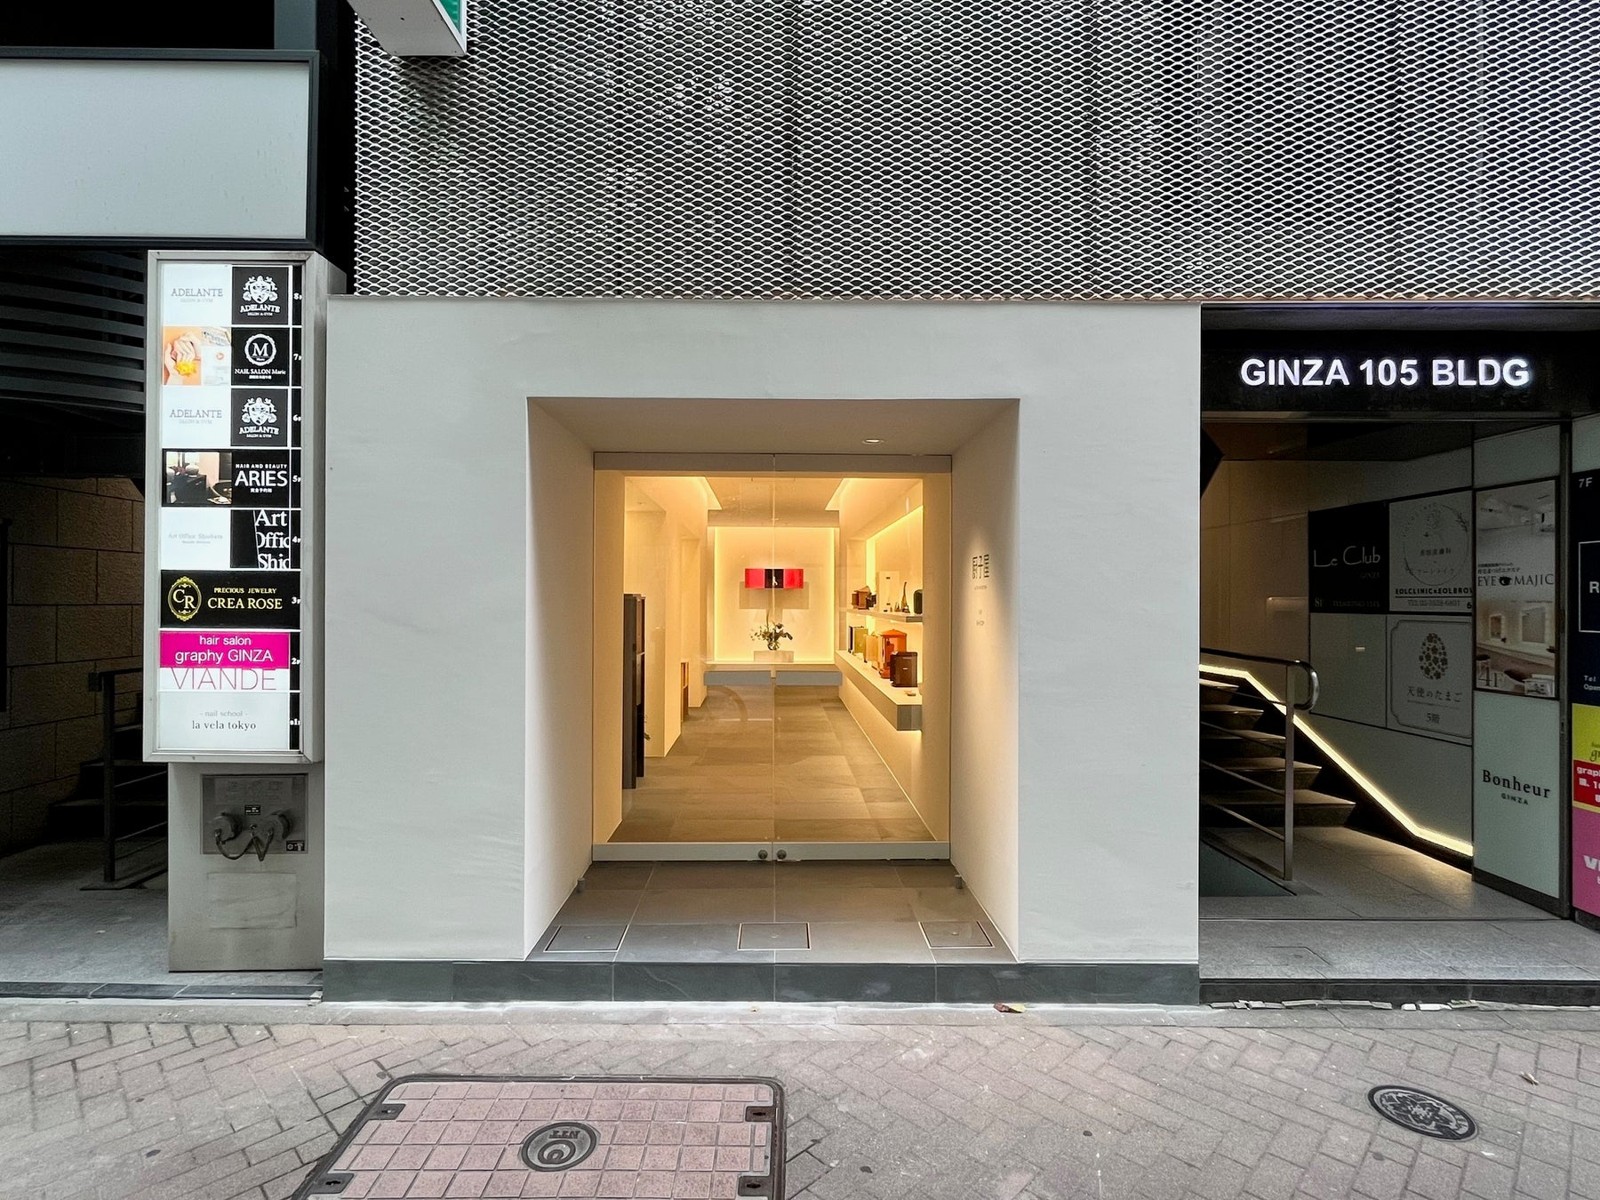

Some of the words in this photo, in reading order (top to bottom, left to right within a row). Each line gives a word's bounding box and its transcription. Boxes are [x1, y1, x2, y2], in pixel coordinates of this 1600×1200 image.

[171, 288, 223, 297] ADELANTE
[240, 304, 280, 313] ADELANTE
[1240, 359, 1350, 386] GINZA
[1359, 359, 1418, 386] 105
[1432, 359, 1530, 386] BLDG
[169, 409, 222, 418] ADELANTE
[239, 426, 279, 435] ADELANTE
[234, 470, 288, 487] ARIES
[1578, 477, 1593, 489] 7F
[255, 509, 287, 527] Art
[1313, 548, 1338, 568] Le
[1342, 545, 1381, 566] Club
[1478, 575, 1496, 587] EYE
[1514, 573, 1554, 587] MAJIC
[207, 597, 245, 610] CREA
[248, 597, 283, 610] ROSE
[199, 635, 219, 645] hair
[223, 635, 252, 645] salon
[175, 649, 223, 665] graphy
[227, 649, 273, 662] GINZA
[170, 666, 277, 691] VIANDE
[192, 719, 200, 729] la
[204, 719, 225, 729] vela
[228, 719, 257, 731] tokyo
[1482, 769, 1551, 799] Bonheur
[1501, 792, 1529, 806] GINZA
